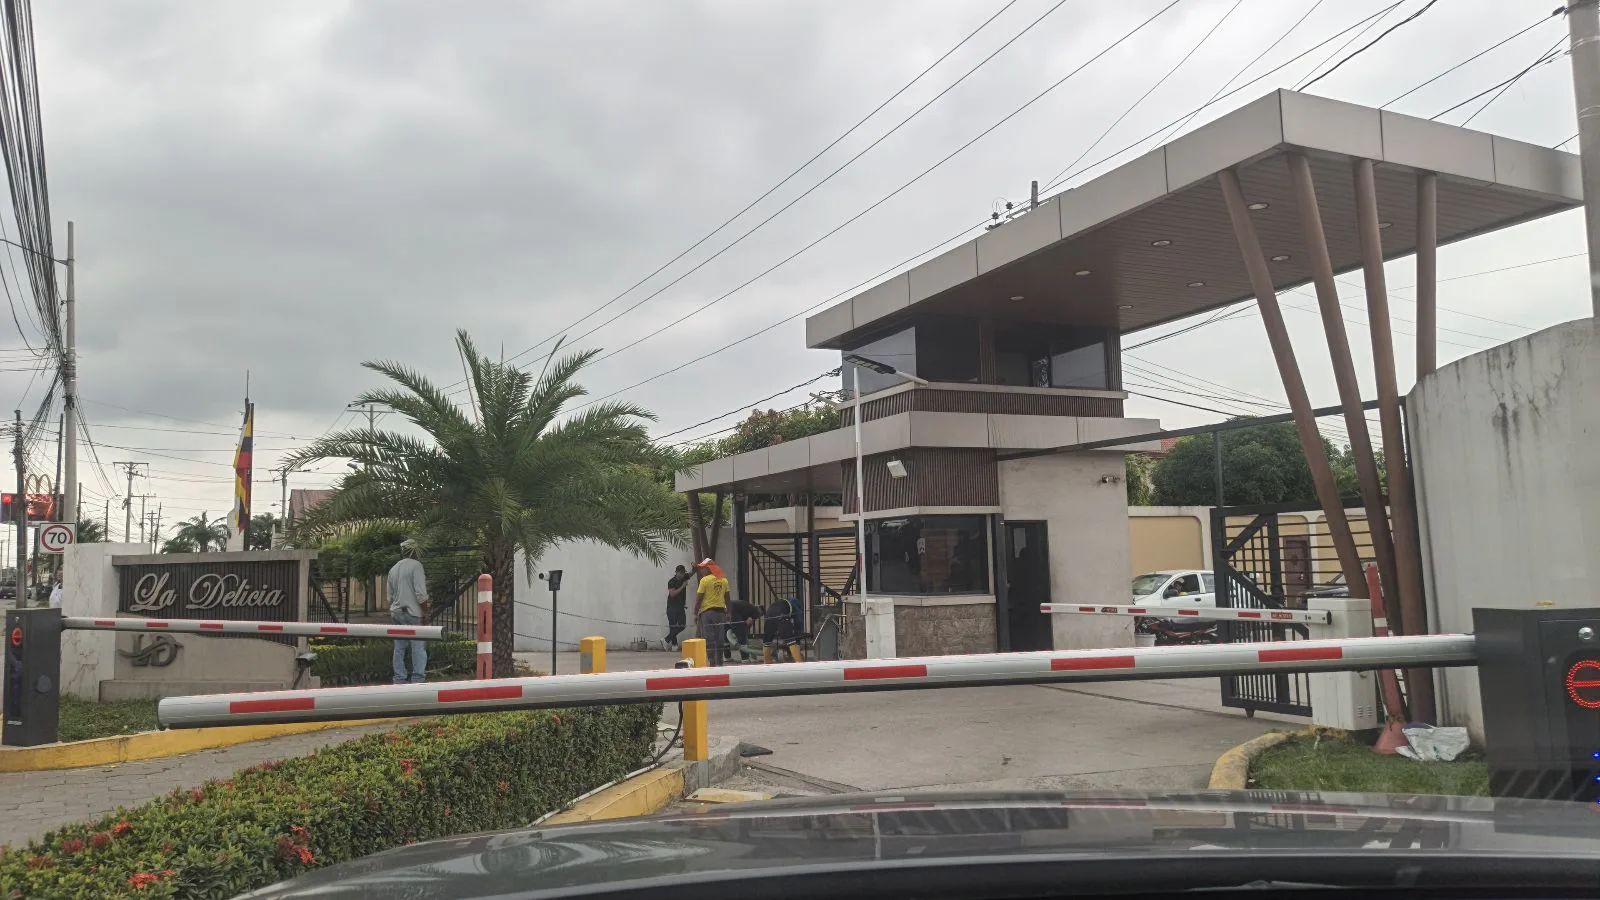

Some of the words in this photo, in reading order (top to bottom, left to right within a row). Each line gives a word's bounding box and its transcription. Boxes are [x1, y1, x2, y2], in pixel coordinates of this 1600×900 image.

[48, 532, 67, 544] 70
[129, 572, 177, 611] La
[185, 573, 285, 610] Delicia
